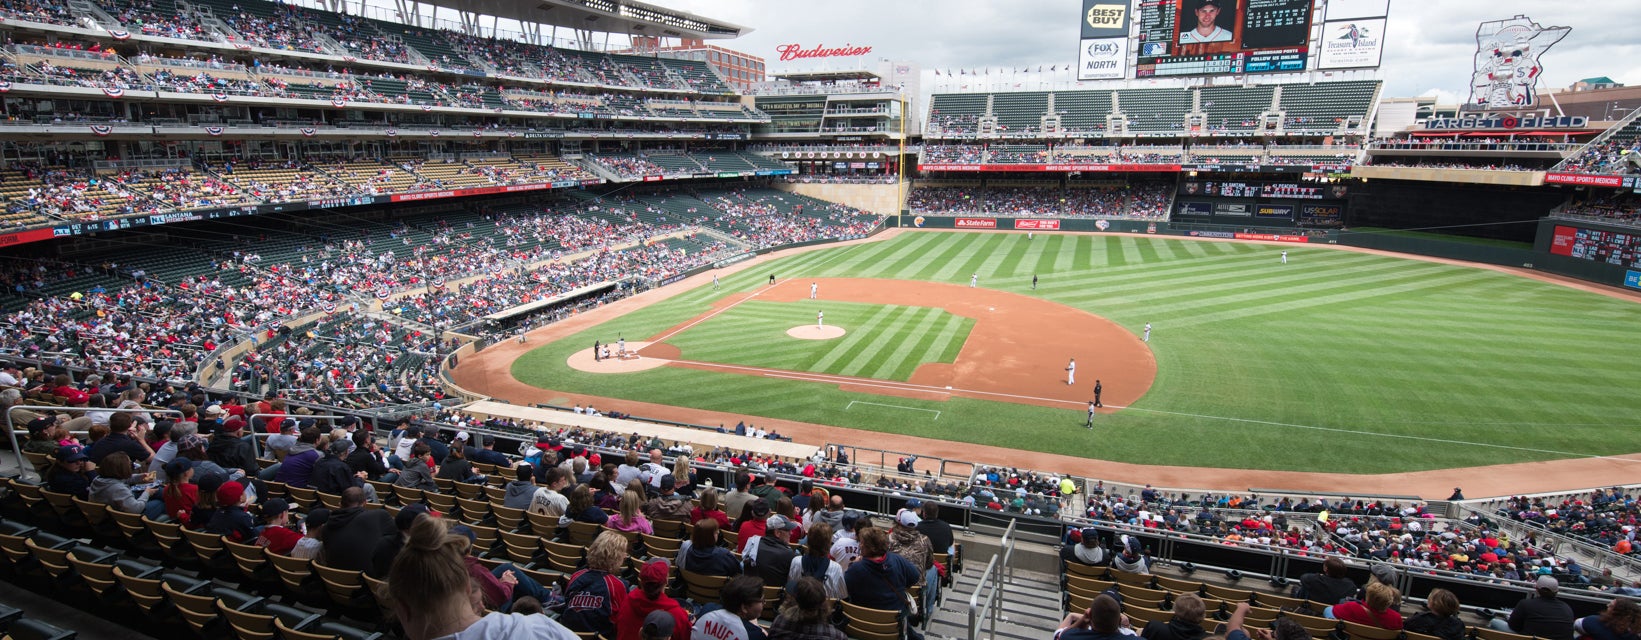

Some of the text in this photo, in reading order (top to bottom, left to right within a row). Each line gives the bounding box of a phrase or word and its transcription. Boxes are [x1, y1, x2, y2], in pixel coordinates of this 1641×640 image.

[776, 43, 872, 61] Budweiser
[1094, 44, 1112, 52] FOX
[1086, 60, 1118, 69] NORTH
[1428, 116, 1588, 129] TARGET FIELD
[704, 620, 739, 640] MAUE
